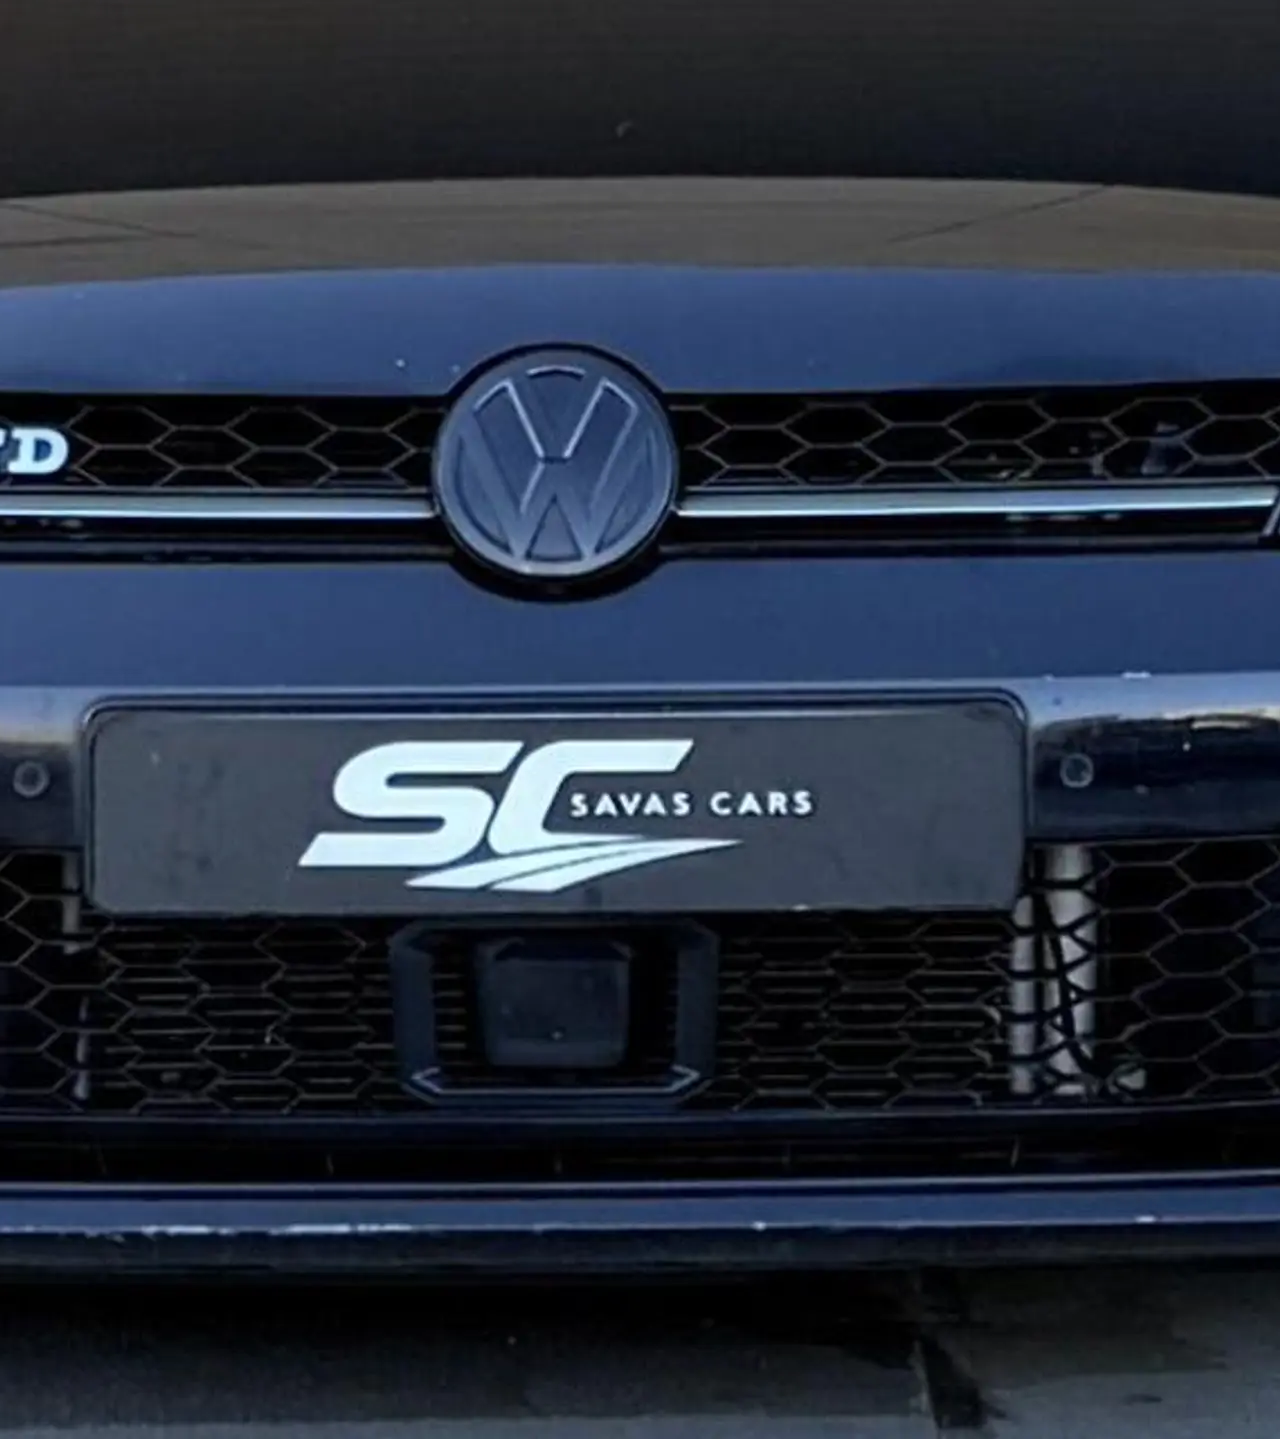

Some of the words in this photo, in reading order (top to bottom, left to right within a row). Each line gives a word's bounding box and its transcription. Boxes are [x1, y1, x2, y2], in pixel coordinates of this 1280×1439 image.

[298, 738, 695, 867] SC
[570, 791, 690, 817] SAVAS
[709, 790, 812, 816] CARS
